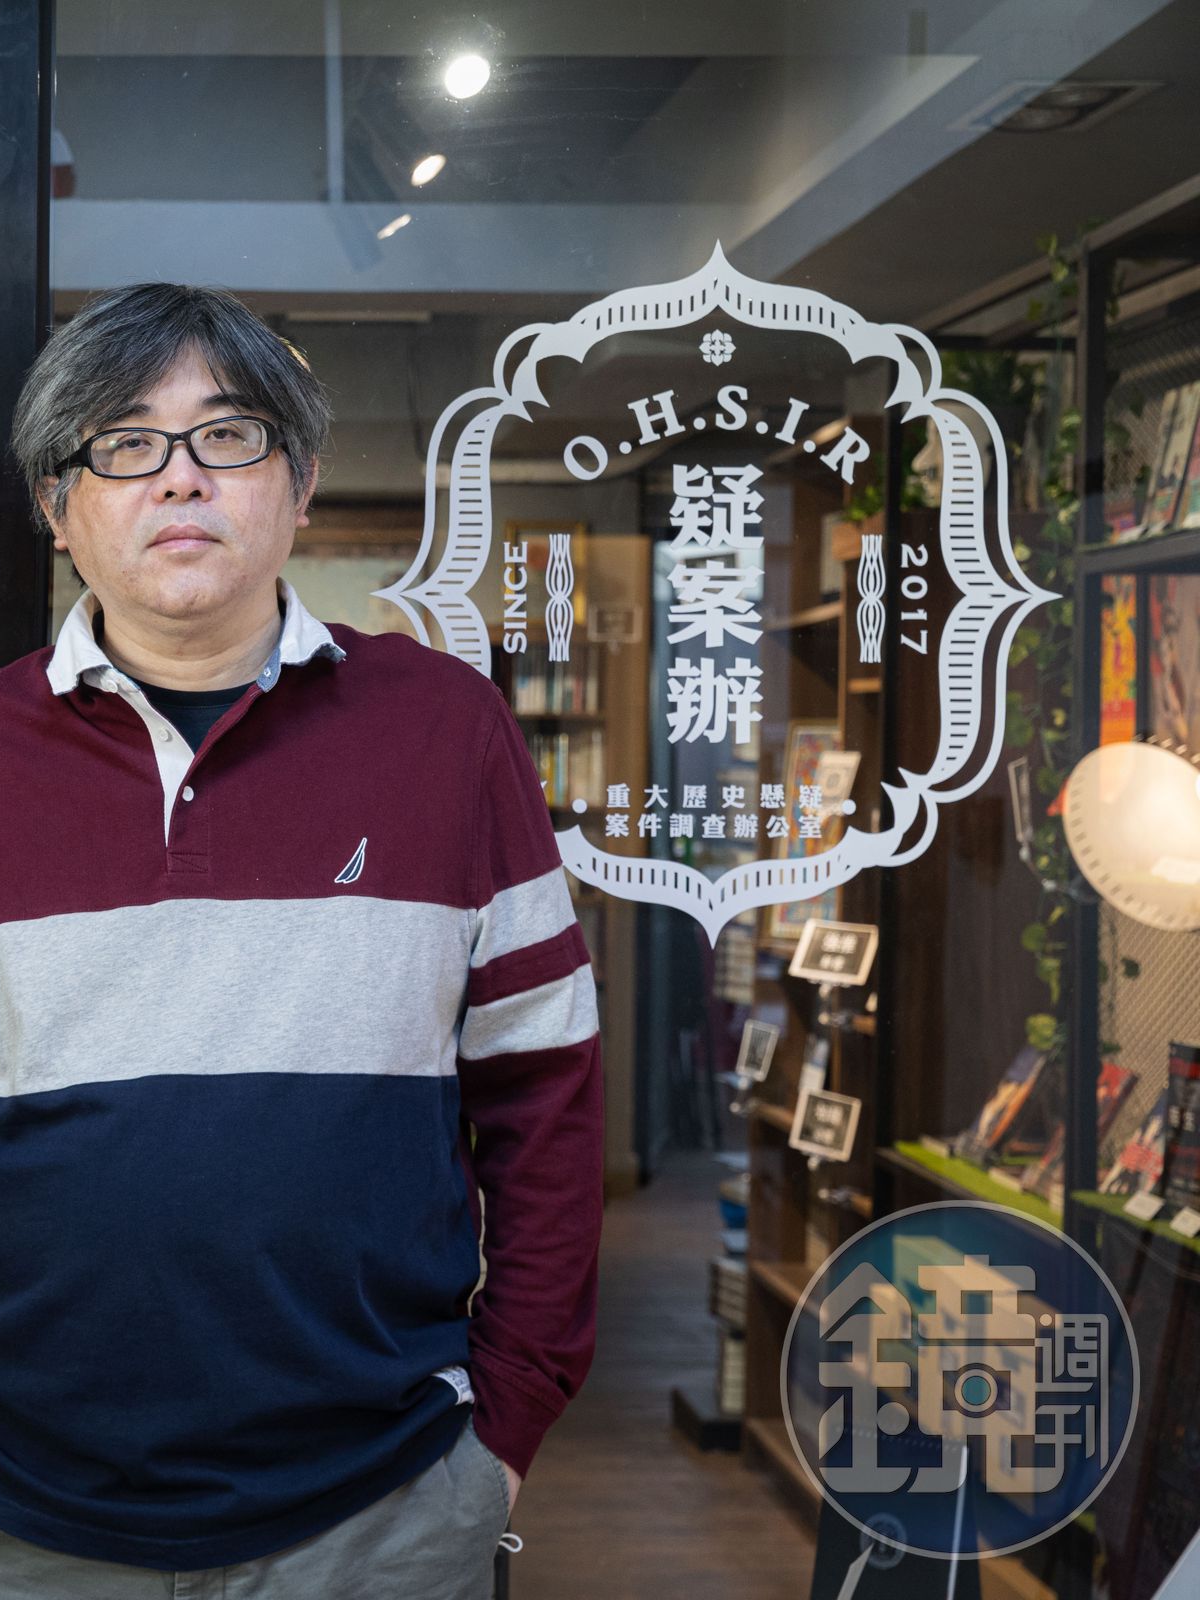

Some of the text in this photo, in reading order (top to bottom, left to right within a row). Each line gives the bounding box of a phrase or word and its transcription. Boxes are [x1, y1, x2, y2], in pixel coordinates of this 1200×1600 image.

[563, 386, 871, 485] O.H.S.I.R
[503, 541, 528, 653] SINCE
[666, 463, 765, 745] 疑案辦
[900, 544, 929, 655] 2017
[605, 813, 823, 839] 案件調查辦公室
[606, 783, 823, 809] 重大歷史懸疑
